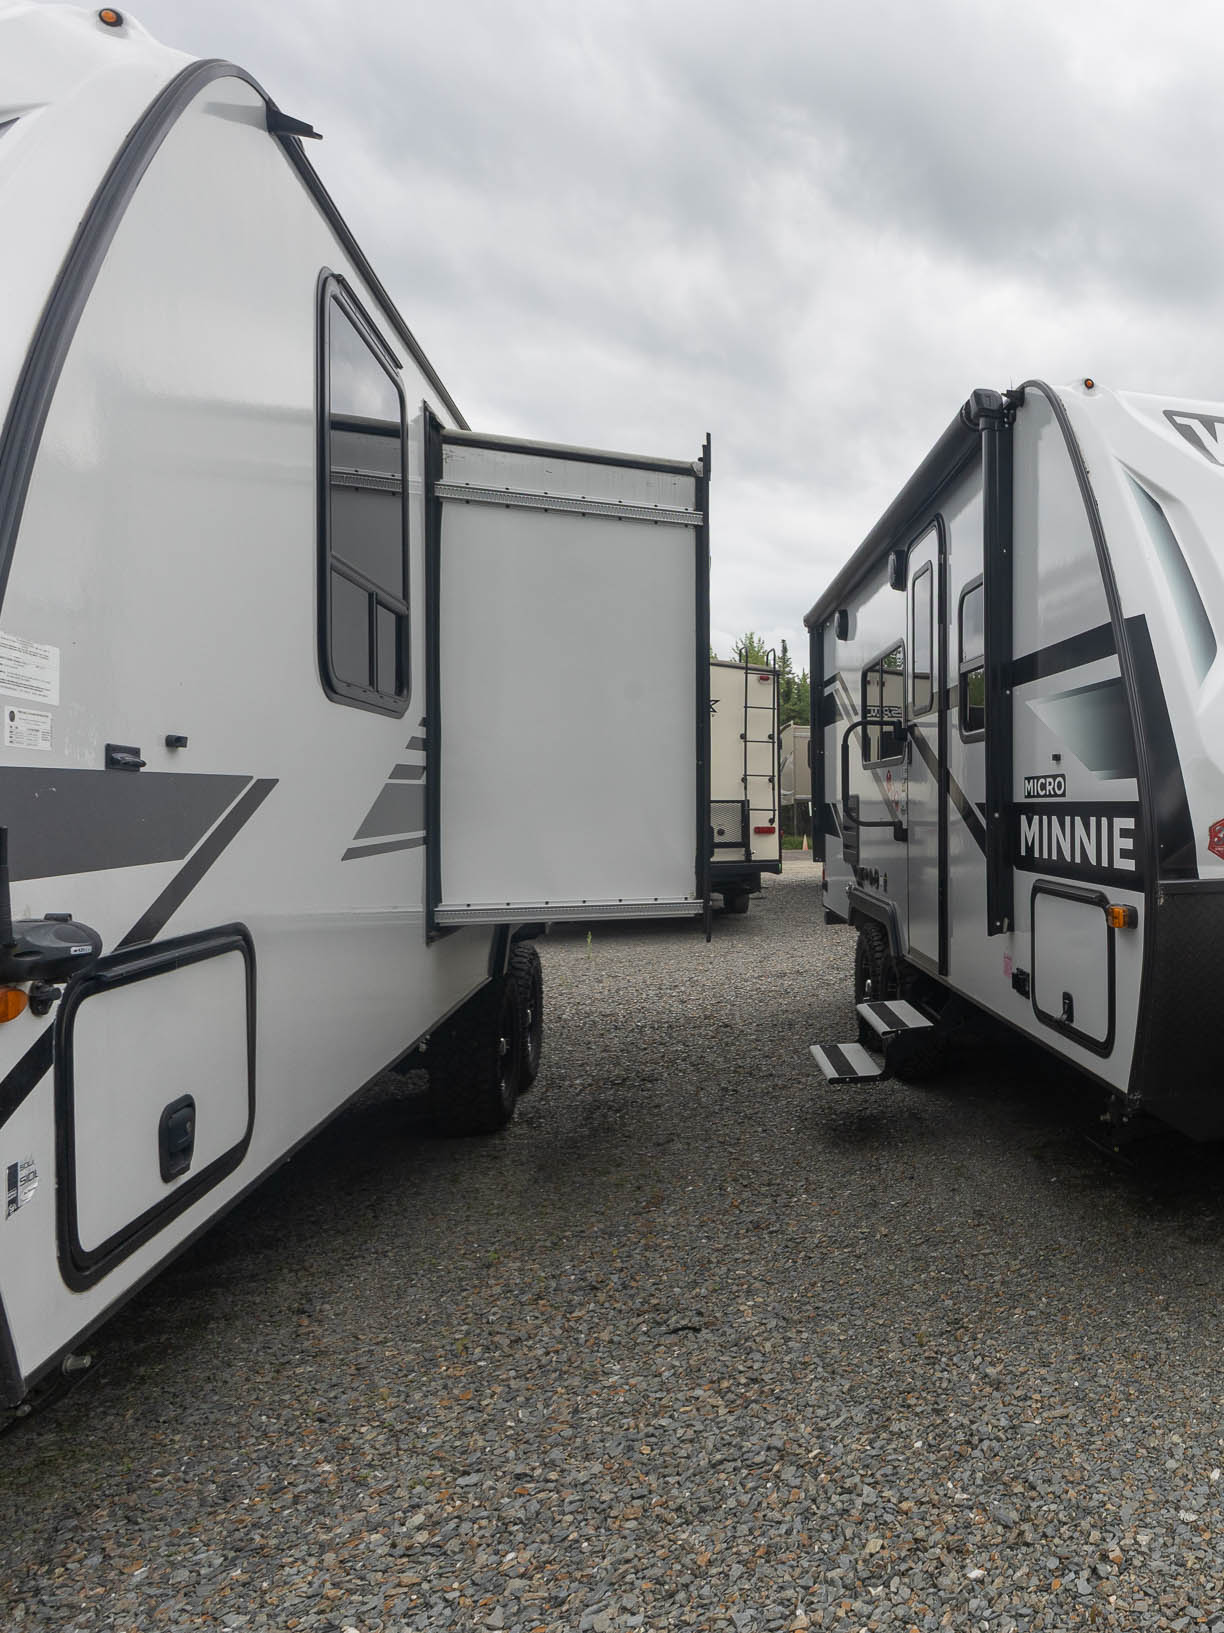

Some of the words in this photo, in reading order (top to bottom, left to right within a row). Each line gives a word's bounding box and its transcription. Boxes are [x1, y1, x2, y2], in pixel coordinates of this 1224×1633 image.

[1024, 776, 1065, 797] MICRO
[1020, 814, 1136, 871] MINNIE
[1214, 825, 1224, 845] 3
